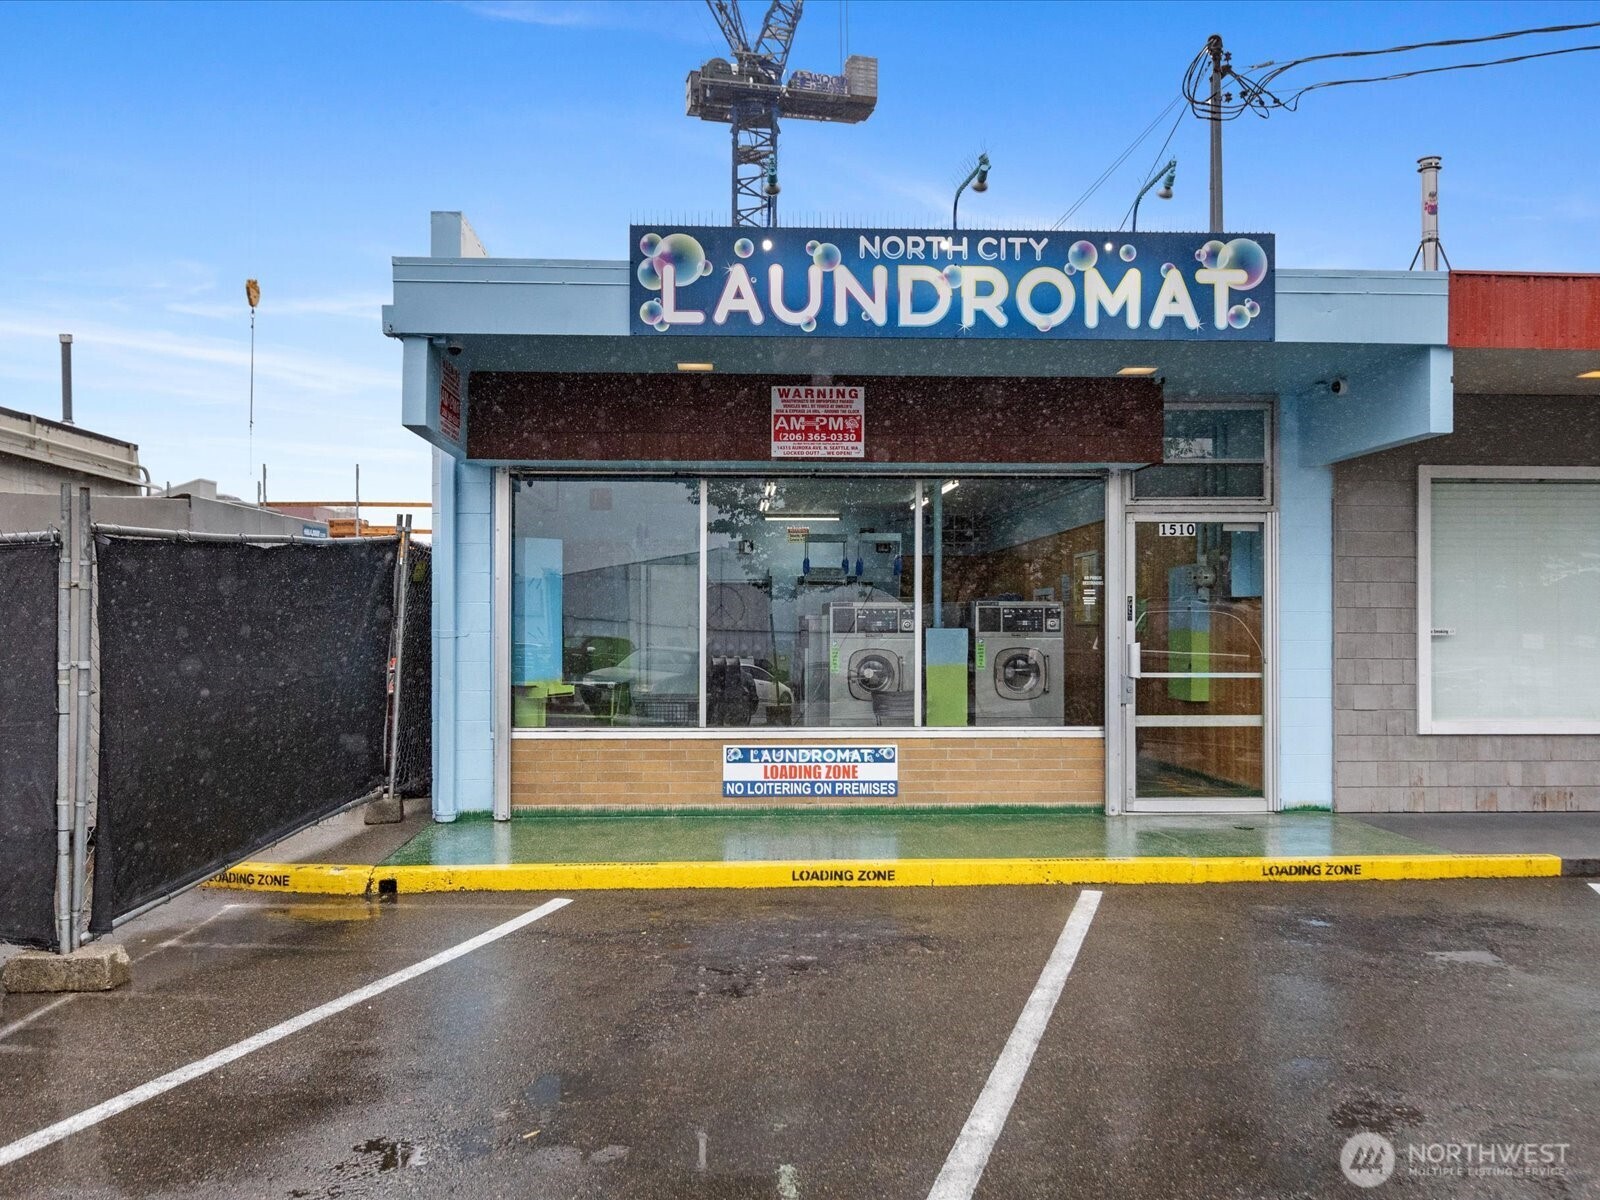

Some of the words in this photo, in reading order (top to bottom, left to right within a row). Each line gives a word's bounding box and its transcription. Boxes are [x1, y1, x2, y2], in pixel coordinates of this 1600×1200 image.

[859, 235, 968, 261] NORTH
[977, 237, 1049, 262] CITY
[661, 262, 1249, 331] LAUNDROMAT
[778, 388, 858, 399] WARNING
[779, 432, 804, 441] (206)
[808, 432, 856, 441] 365-0330
[1162, 524, 1194, 535] 1510
[750, 749, 872, 763] LAUNDROMAT
[764, 765, 822, 779] LOADING
[825, 765, 858, 779] ZONE
[726, 783, 744, 794] NO
[748, 783, 811, 794] LOITERING
[814, 783, 831, 794] ON
[836, 783, 896, 794] PREMISES
[792, 870, 853, 881] LOADING
[858, 870, 895, 881] ZONE
[1262, 865, 1321, 876] LOADING
[1325, 864, 1362, 875] ZONE
[257, 874, 290, 886] ZONE
